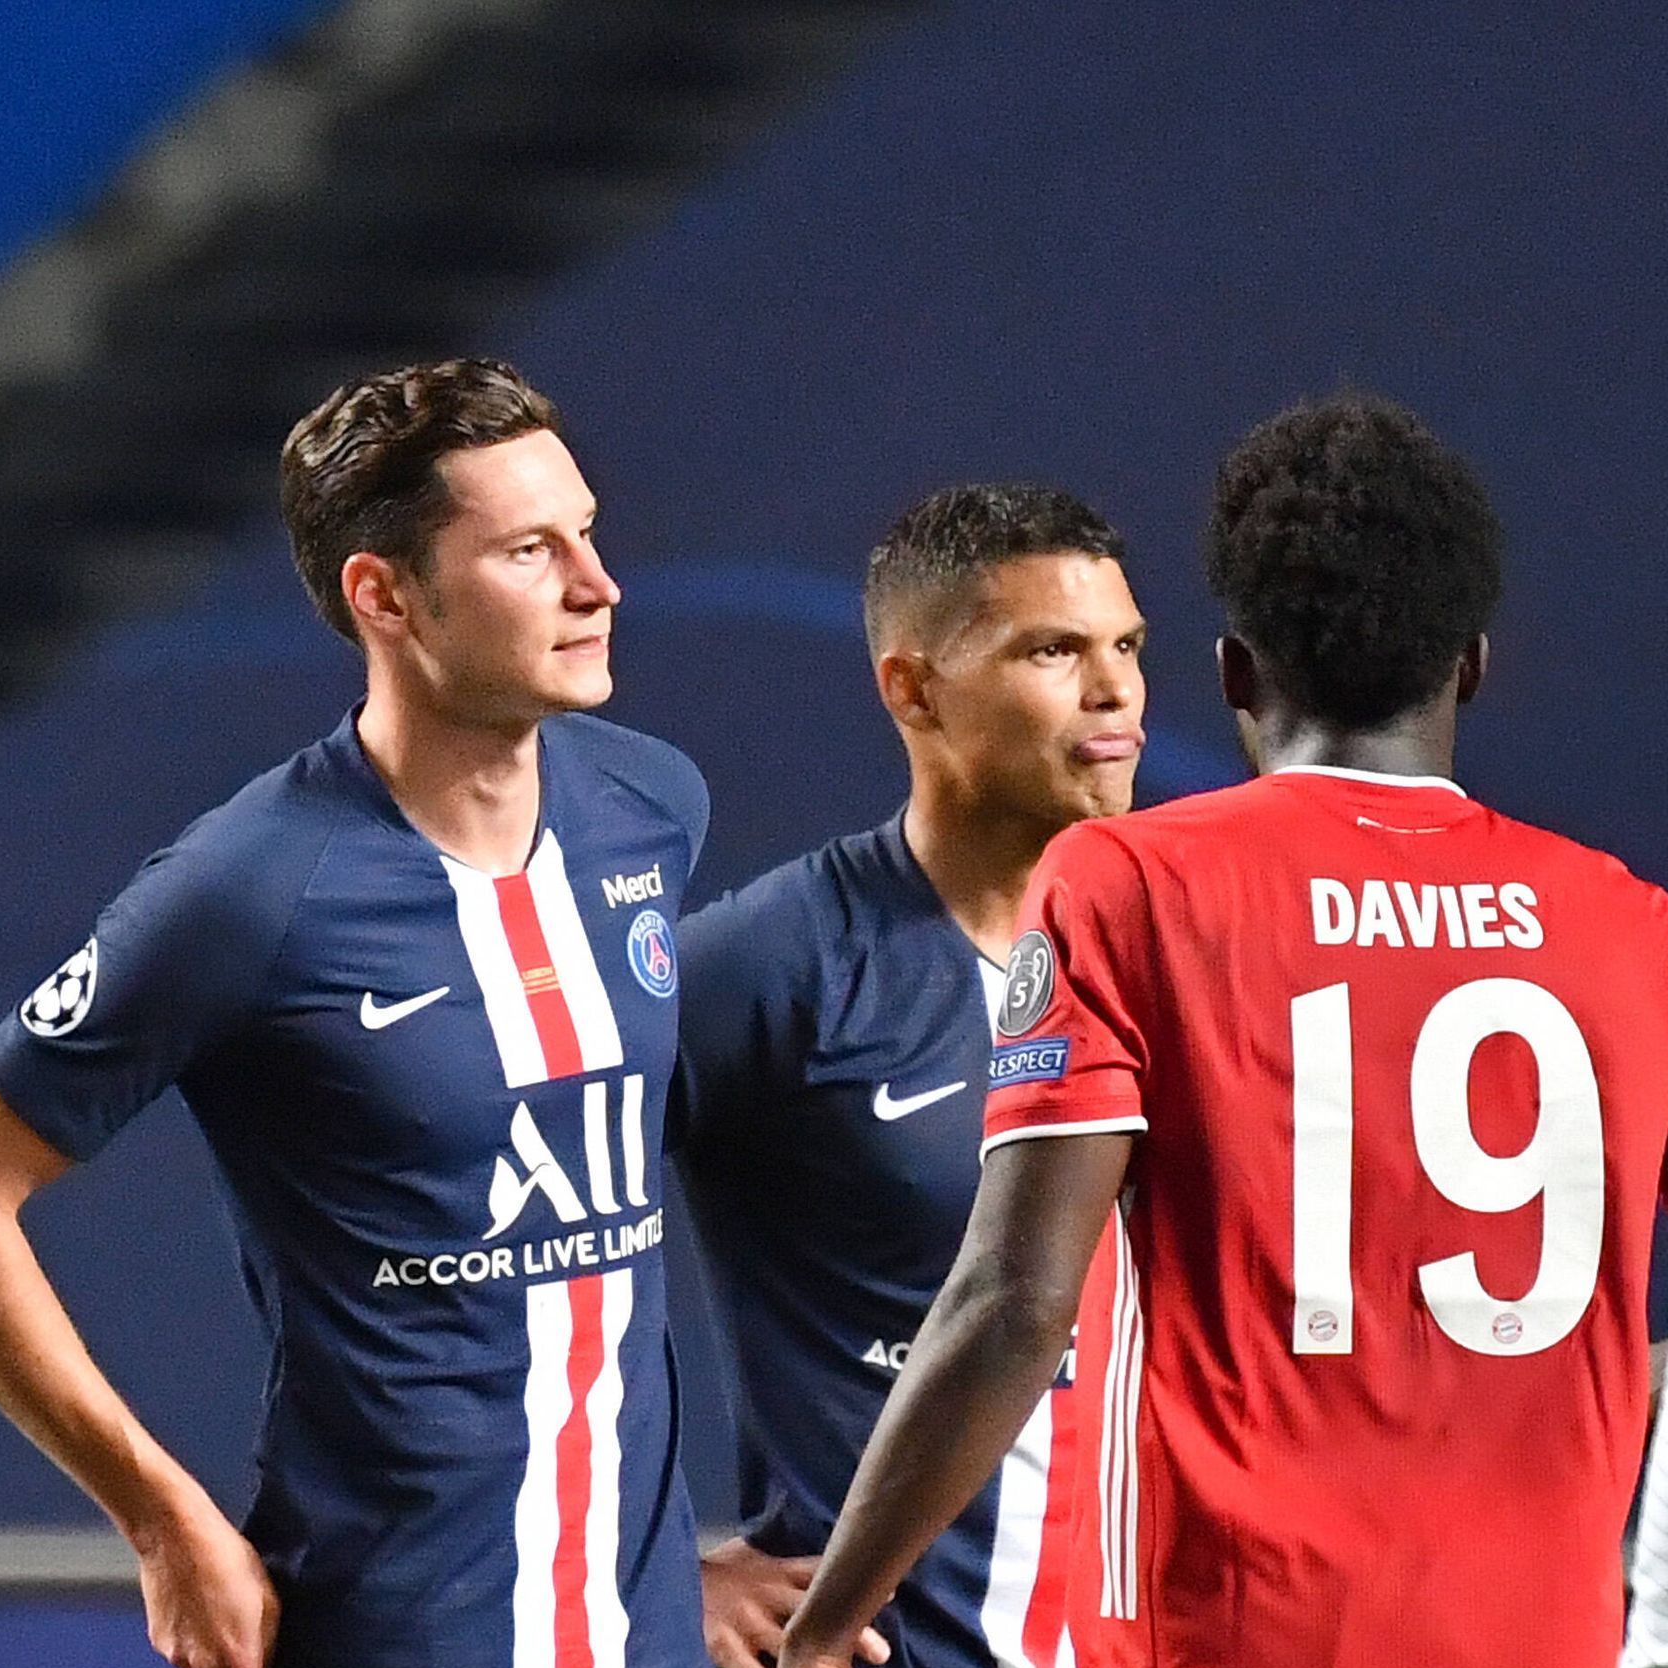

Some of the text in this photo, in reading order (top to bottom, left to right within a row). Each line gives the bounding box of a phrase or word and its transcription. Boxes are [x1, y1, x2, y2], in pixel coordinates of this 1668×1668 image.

[601, 863, 664, 909] Merci
[1310, 877, 1544, 949] DAVIES
[1012, 981, 1029, 1009] 5
[1290, 976, 1606, 1357] 19
[372, 1248, 516, 1287] ACCOR
[523, 1231, 600, 1275] LIVE
[861, 1338, 909, 1371] AC
